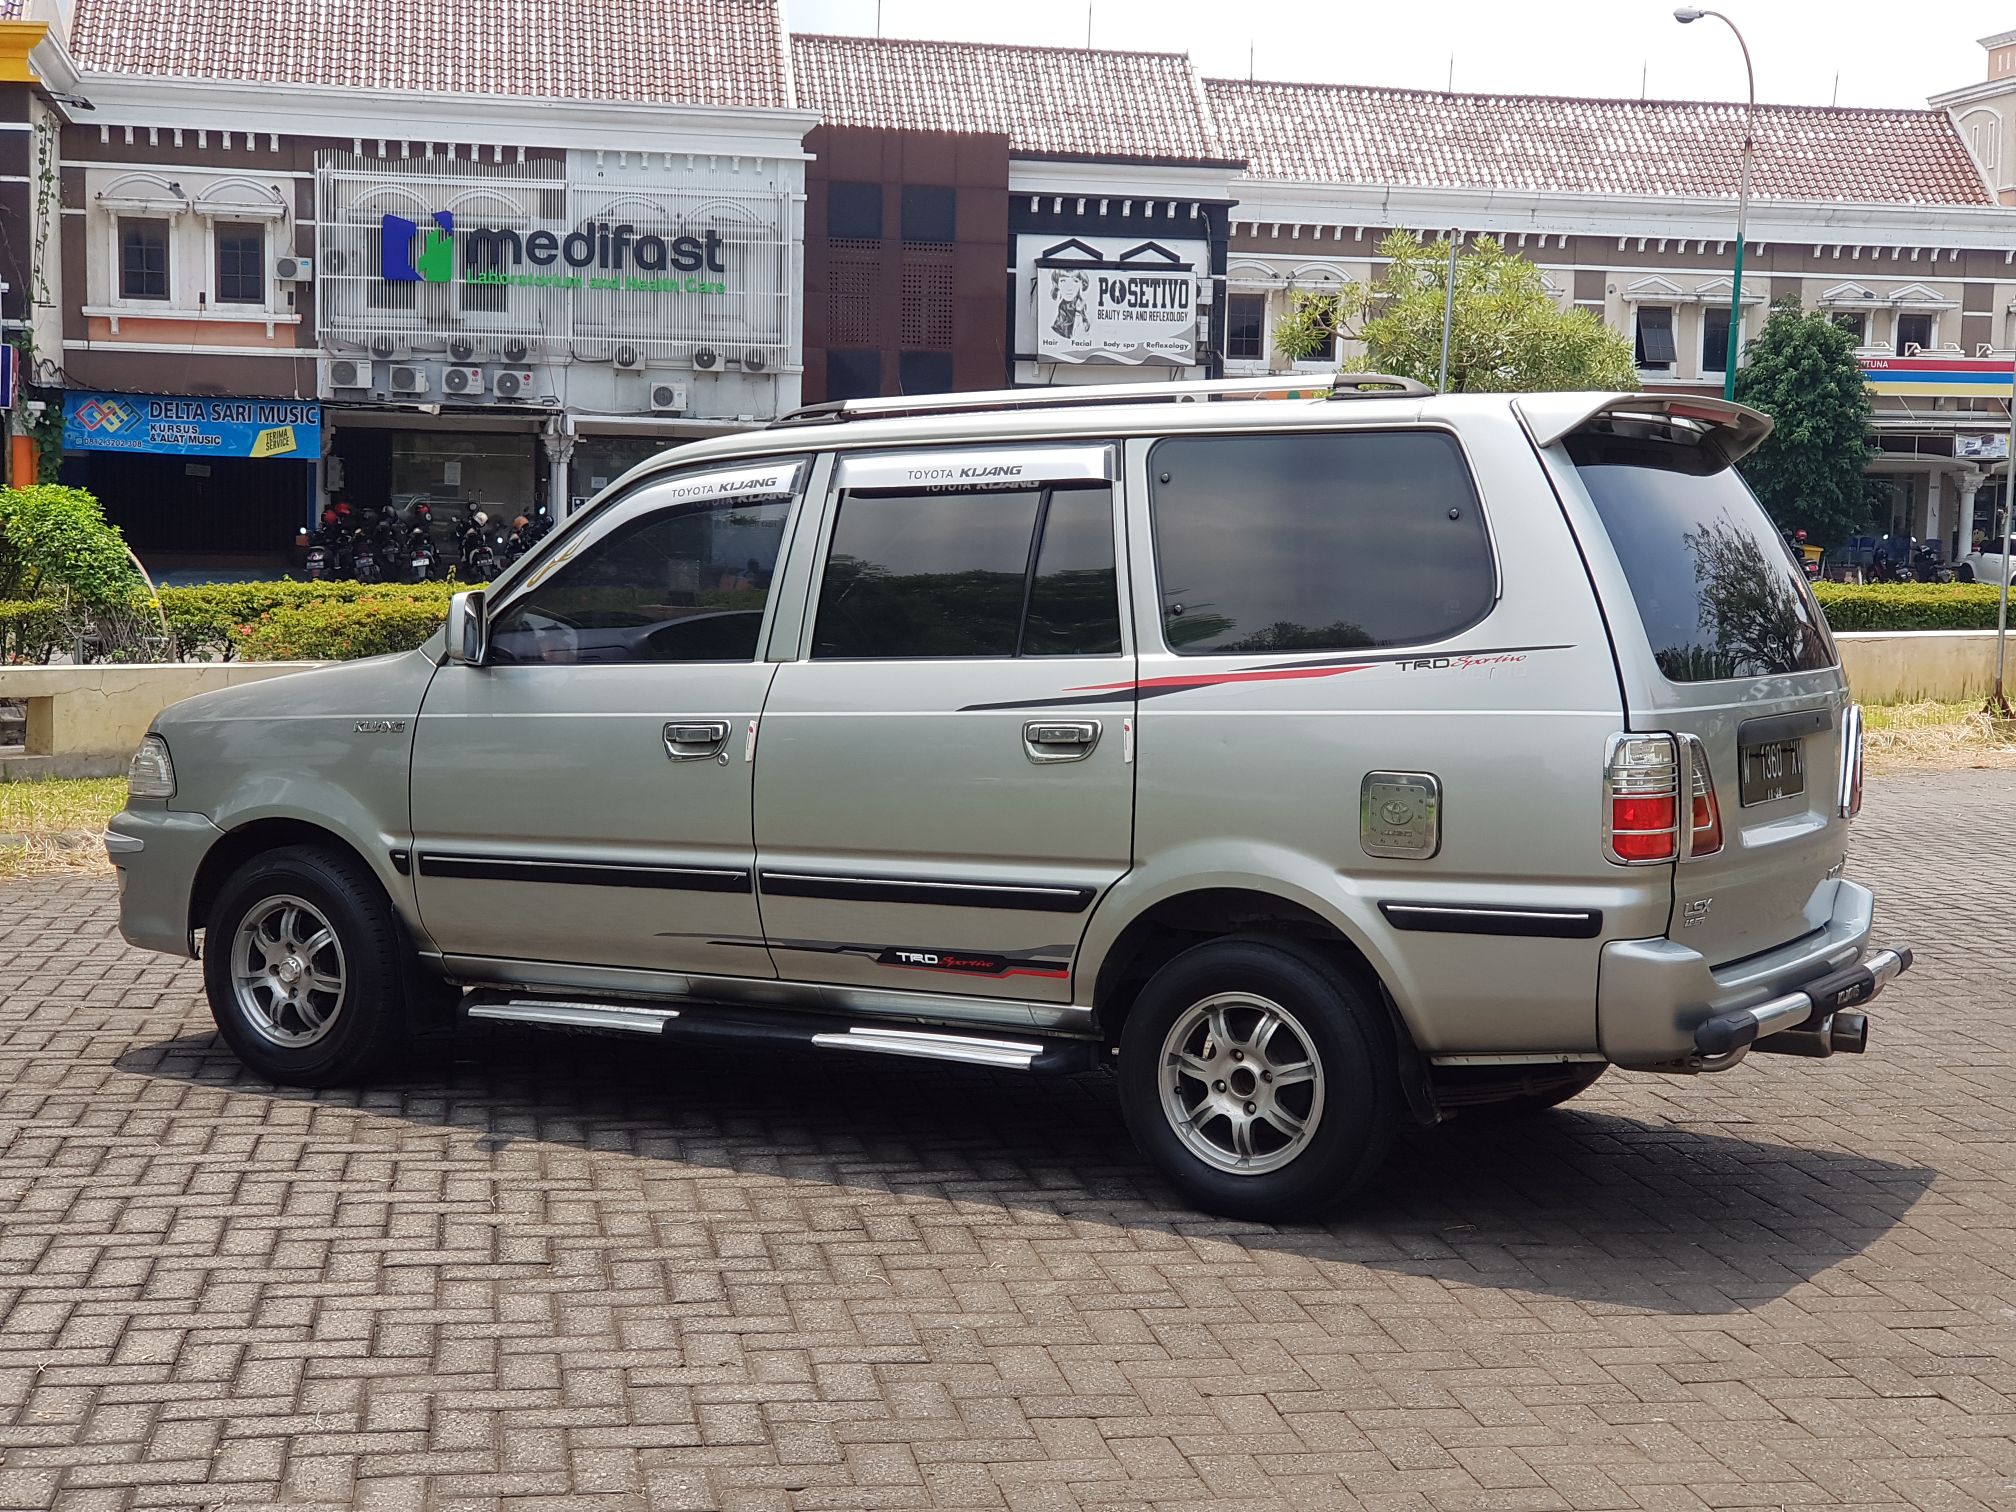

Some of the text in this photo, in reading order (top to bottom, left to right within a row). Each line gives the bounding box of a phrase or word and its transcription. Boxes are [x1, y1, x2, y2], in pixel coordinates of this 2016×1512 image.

[466, 222, 725, 273] medifast
[466, 269, 726, 294] Laboratorium and Health Care
[1098, 277, 1189, 309] POSETIVO
[1098, 309, 1188, 322] BEAUTY SPA AND REFLEXOLOGY
[1071, 339, 1092, 347] Facial
[1146, 341, 1189, 350] Reflexology
[150, 401, 318, 425] DELTA SARI MUSIC
[150, 424, 198, 434] KURSUS
[266, 428, 288, 442] TERIMA
[150, 434, 221, 445] & ALAT MUSIC
[266, 436, 289, 451] SERVICE
[907, 465, 1023, 480] TOYOTA KIJANG
[671, 477, 778, 498] TOYOTA KIJANG
[1395, 658, 1450, 671] TRD
[1760, 743, 1783, 780] 1360
[896, 952, 938, 964] TRD
